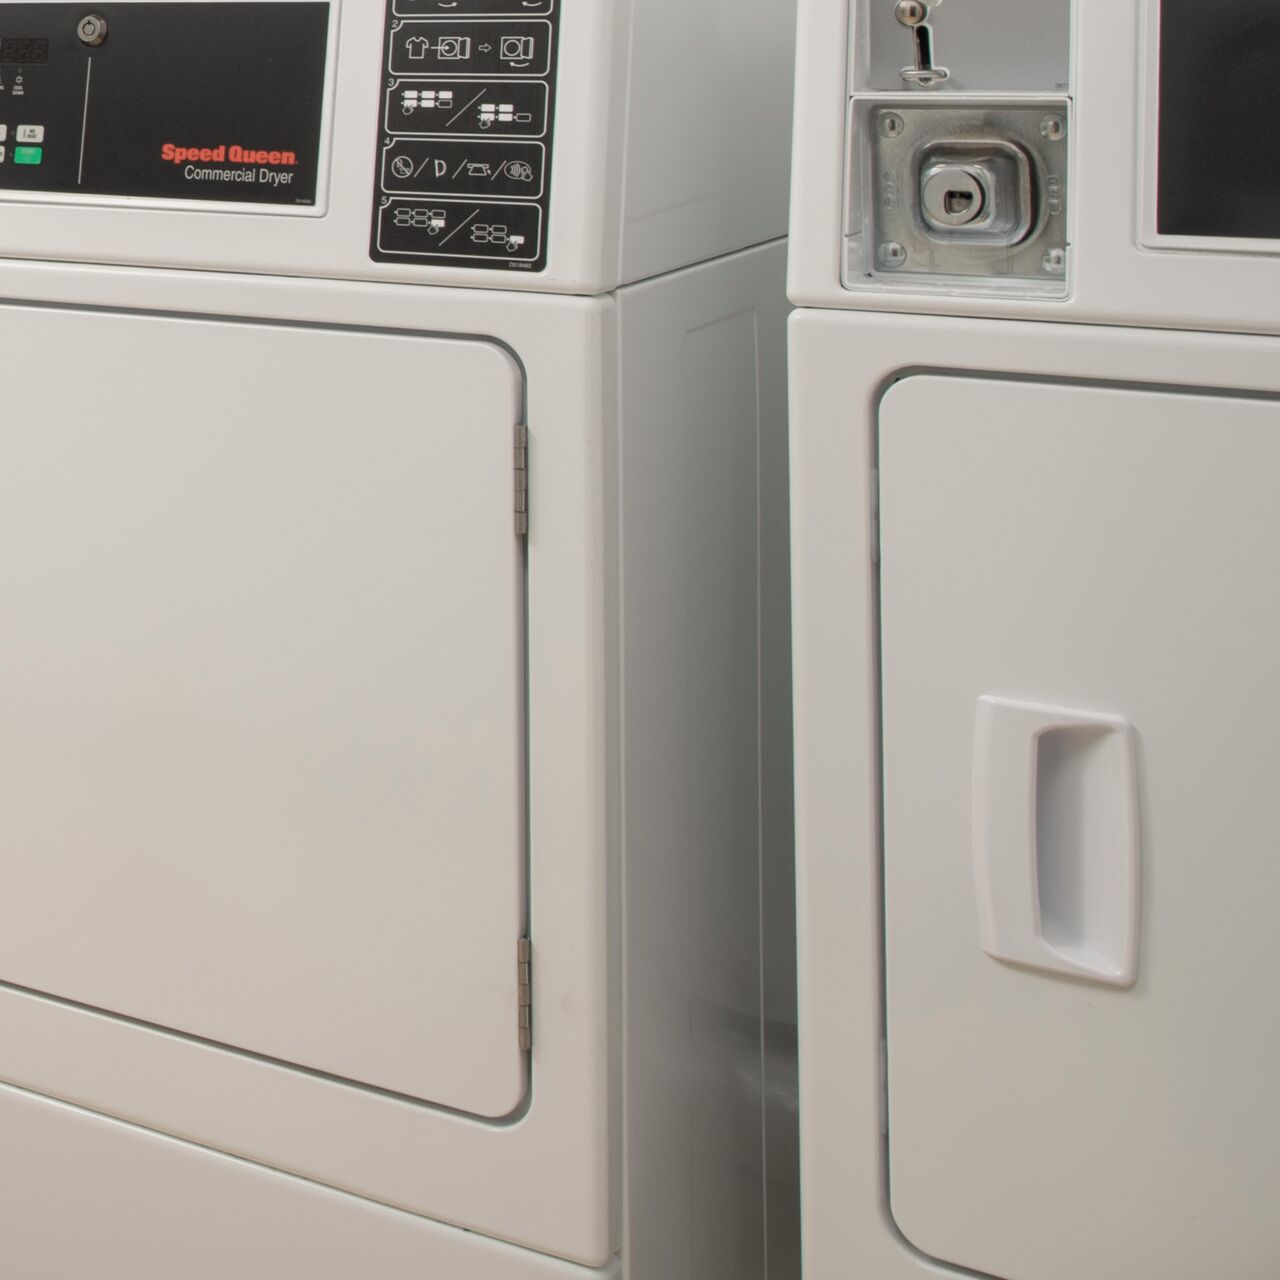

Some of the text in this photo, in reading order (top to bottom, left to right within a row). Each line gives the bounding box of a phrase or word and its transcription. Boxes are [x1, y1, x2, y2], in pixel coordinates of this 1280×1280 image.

[392, 20, 399, 28] 2
[388, 78, 395, 87] 3
[384, 137, 390, 145] 4
[161, 143, 296, 165] Speed Queen
[184, 165, 294, 187] Commercial Dryer
[381, 196, 388, 205] 5
